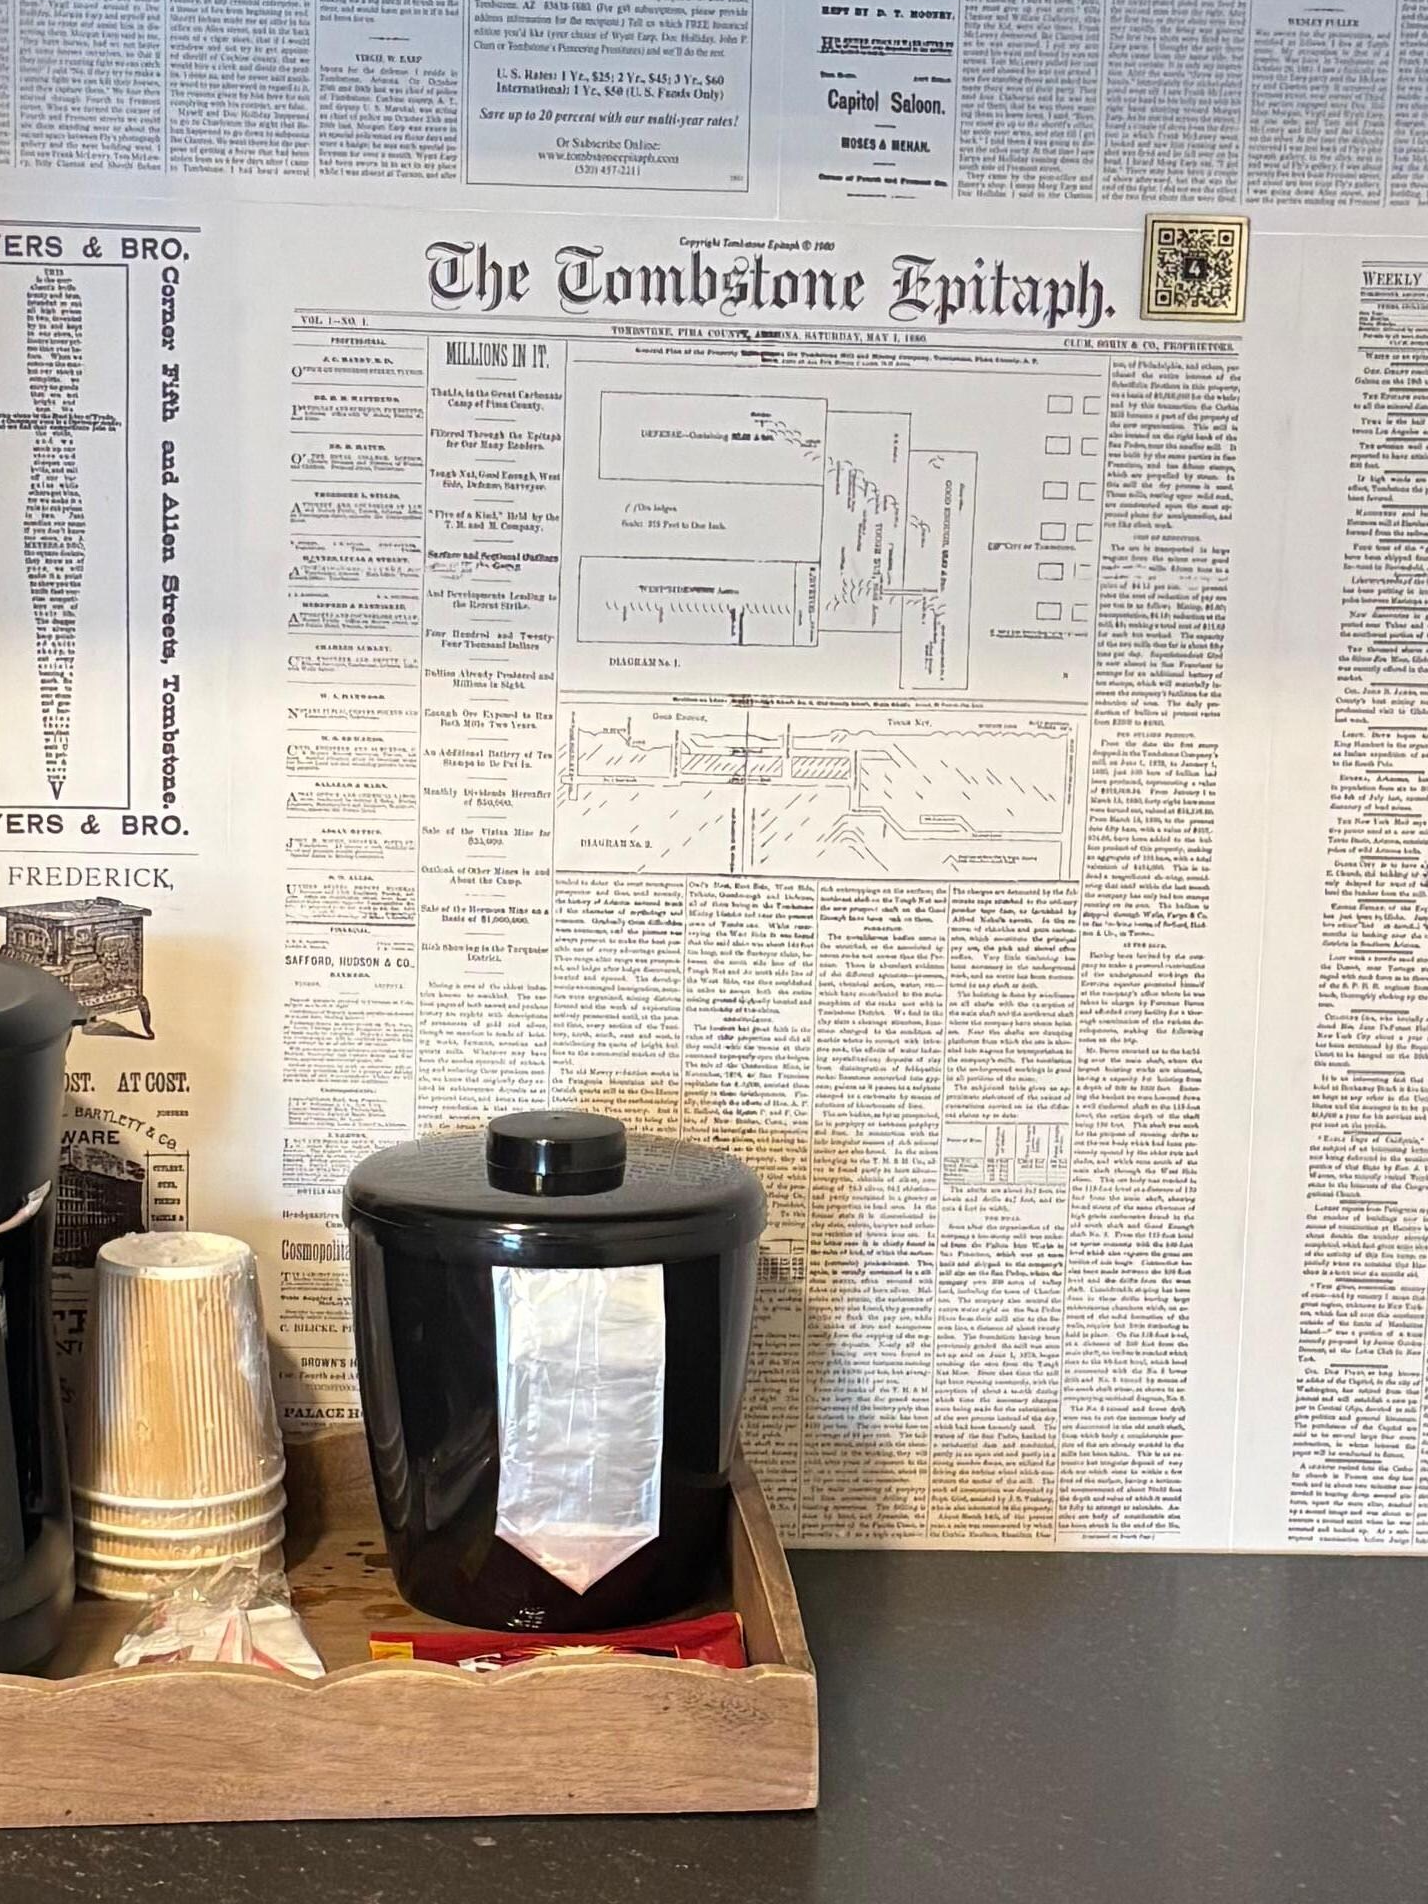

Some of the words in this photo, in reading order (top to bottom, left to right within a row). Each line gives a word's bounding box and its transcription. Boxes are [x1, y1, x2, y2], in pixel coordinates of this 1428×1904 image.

[480, 108, 505, 121] Save
[508, 111, 522, 123] up
[525, 111, 536, 120] to
[539, 110, 552, 122] 20
[555, 110, 595, 124] percent
[599, 112, 622, 124] with
[625, 115, 644, 124] our
[827, 90, 883, 115] Capitol
[891, 92, 946, 117] Saloon.
[83, 238, 102, 258] &
[121, 238, 190, 260] BRO.
[1183, 254, 1209, 283] 4
[1362, 271, 1423, 287] WEEKLY
[427, 240, 531, 314] The
[558, 245, 866, 317] Tombstone
[893, 254, 1116, 326] Epitaph.
[162, 267, 179, 351] Corner
[446, 342, 503, 367] MILLIONS
[513, 344, 528, 368] IN
[533, 345, 550, 370] IT.
[162, 366, 178, 422] Fifth
[162, 440, 178, 483] and
[162, 493, 178, 561] Allen
[162, 575, 179, 665] Streets,
[80, 815, 100, 834] &
[122, 815, 189, 836] BRO.
[9, 867, 175, 892] FREDERICK,
[339, 957, 380, 967] HUDSON
[383, 959, 391, 968] &
[118, 1074, 141, 1092] AT
[145, 1073, 190, 1093] COST.
